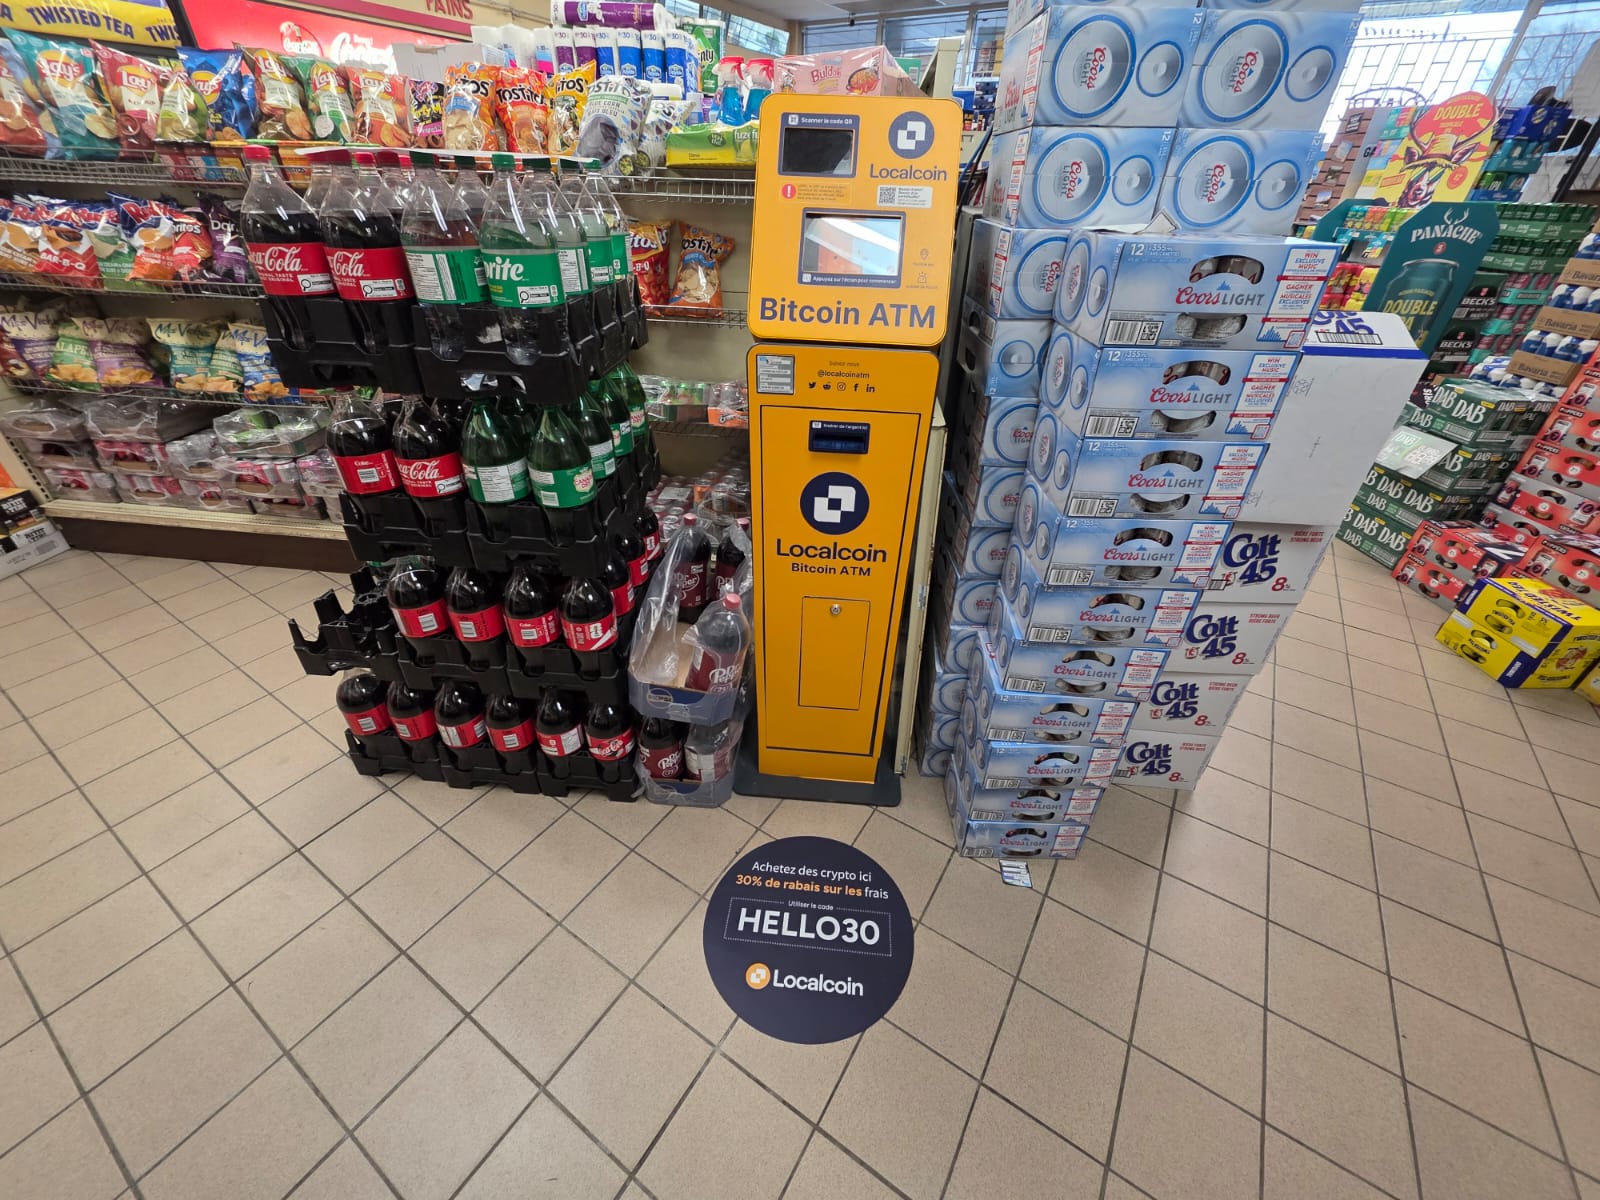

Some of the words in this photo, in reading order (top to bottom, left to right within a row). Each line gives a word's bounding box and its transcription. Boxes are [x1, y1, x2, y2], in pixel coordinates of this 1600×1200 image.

[26, 6, 101, 28] TWISTED
[102, 15, 134, 39] TEA
[700, 50, 713, 64] nty
[1080, 52, 1093, 86] LIGHT
[1088, 47, 1106, 90] Coors
[1228, 56, 1245, 90] LIGHT
[1233, 51, 1258, 93] Coors
[1434, 103, 1483, 120] DOUBLE
[1162, 130, 1171, 141] 12
[870, 163, 947, 181] Localcoin
[1061, 165, 1071, 195] LIGHT
[1067, 161, 1083, 199] Coors
[1207, 164, 1226, 203] Coors
[172, 223, 201, 234] oritos
[1130, 244, 1145, 256] 12
[40, 252, 86, 271] BAR-B-Q
[484, 256, 524, 281] prite
[1175, 287, 1220, 304] Coors
[1220, 293, 1264, 305] LIGHT
[1461, 297, 1496, 306] BECK'S
[760, 297, 860, 325] Bitcoin
[868, 303, 936, 329] ATM
[1383, 300, 1439, 315] DOUBLE
[1440, 341, 1473, 349] BECK'S
[1108, 351, 1121, 361] 12
[817, 369, 870, 379] @localcoinatm
[1150, 387, 1191, 403] Coors
[1192, 393, 1232, 403] LIGHT
[1433, 386, 1458, 408] DAB
[1452, 400, 1486, 423] DAB
[1498, 402, 1515, 411] DAB
[1410, 410, 1433, 428] DAB
[1088, 441, 1101, 450] 12
[1441, 452, 1463, 471] AB
[1474, 452, 1491, 460] DAB
[1128, 474, 1167, 488] Coors
[1167, 479, 1204, 488] LIGHT
[1377, 476, 1405, 499] DAB
[1366, 493, 1387, 510] DAB
[1404, 489, 1435, 513] DAB
[1066, 520, 1077, 528] 12
[1353, 513, 1379, 536] DAB
[1343, 529, 1362, 547] DAB
[1377, 527, 1407, 551] DAB
[776, 538, 887, 562] Localcoin
[1104, 549, 1139, 561] Coors
[1140, 553, 1175, 561] LIGHT
[1223, 533, 1281, 567] Colt
[791, 562, 836, 574] Bitcoin
[840, 566, 871, 576] ATM
[1239, 558, 1279, 584] 45
[1079, 610, 1113, 622] Coors
[1114, 615, 1148, 623] LIGHT
[1186, 614, 1239, 644] Colt
[1202, 636, 1237, 657] 45
[1053, 665, 1086, 676] Coors
[1087, 670, 1118, 679] LIGHT
[1151, 681, 1199, 706] Colt
[1165, 701, 1198, 719] 45
[1032, 716, 1062, 726] Coors
[1062, 720, 1092, 728] LIGHT
[1127, 742, 1172, 764] Colt
[1027, 766, 1056, 775] Coors
[1142, 759, 1171, 775] 45
[752, 861, 796, 875] Achetez
[798, 865, 818, 877] des
[820, 869, 857, 882] crypto
[859, 871, 872, 882] ici
[735, 874, 762, 887] 30%
[765, 877, 781, 888] de
[783, 879, 820, 892] rabais
[823, 884, 842, 894] sur
[845, 885, 862, 896] les
[864, 886, 889, 899] frais
[788, 900, 810, 908] Utiliser
[737, 908, 880, 945] HELLO30
[773, 969, 864, 997] Localcoin
